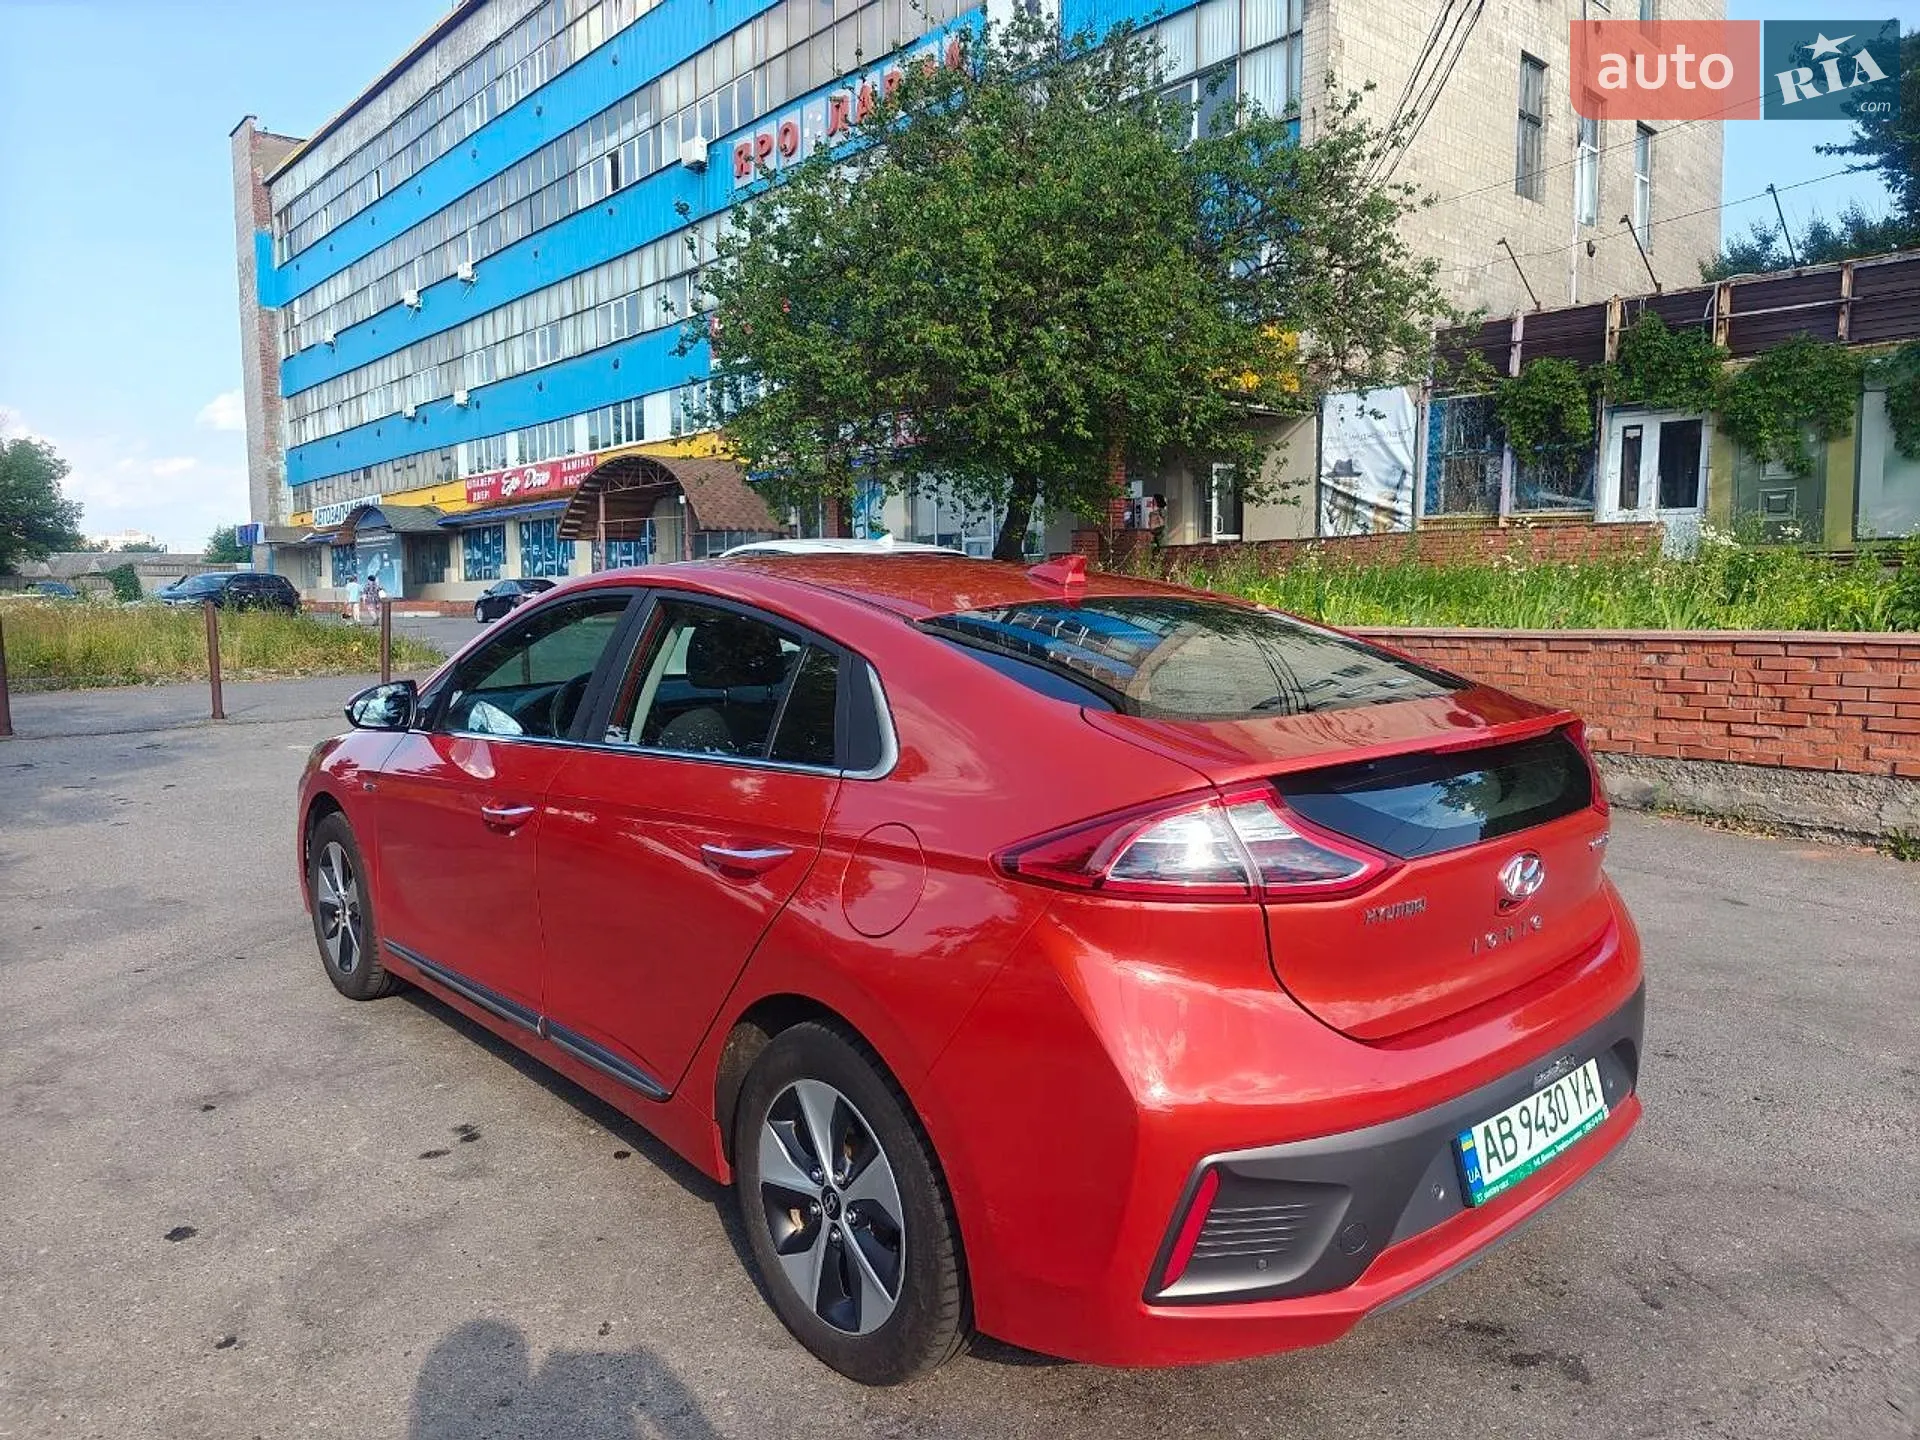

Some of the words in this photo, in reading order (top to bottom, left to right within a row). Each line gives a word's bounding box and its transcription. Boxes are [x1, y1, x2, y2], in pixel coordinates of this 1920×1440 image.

[1364, 897, 1427, 926] HYUNDAI
[1483, 1114, 1518, 1174] AB
[1519, 1083, 1570, 1151] 9430
[1568, 1065, 1598, 1114] YA
[1467, 1166, 1482, 1184] UA
